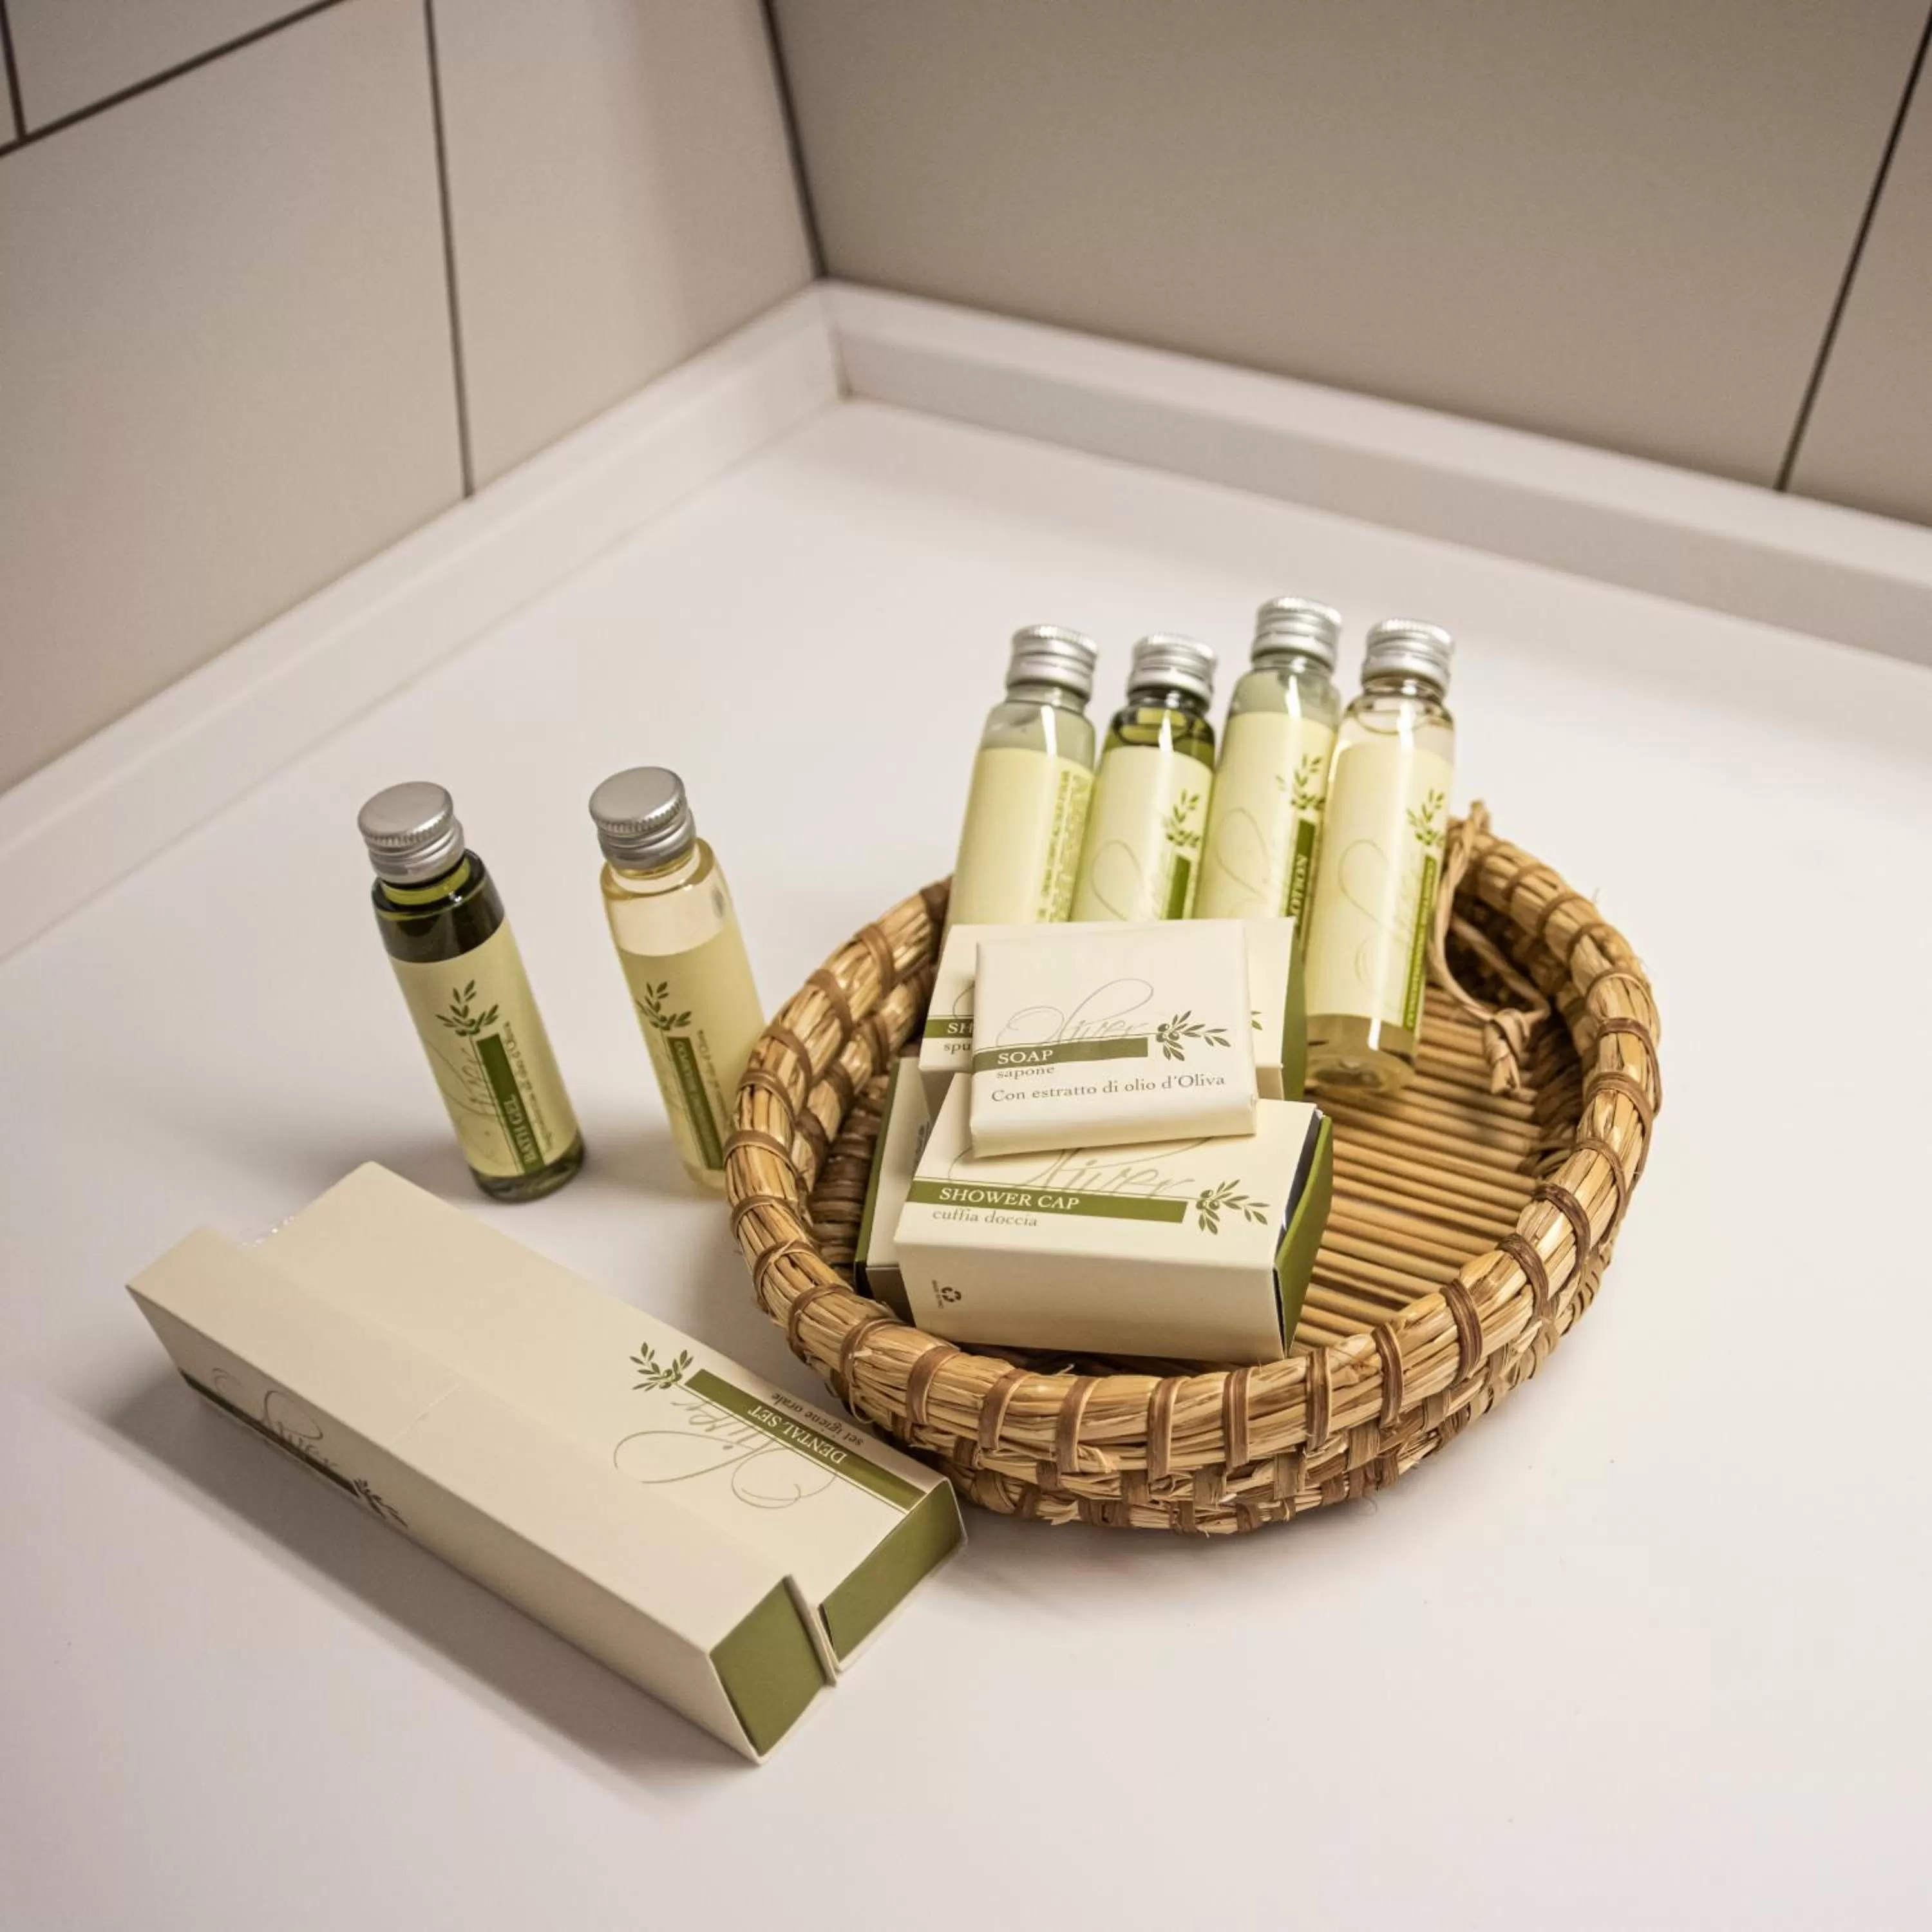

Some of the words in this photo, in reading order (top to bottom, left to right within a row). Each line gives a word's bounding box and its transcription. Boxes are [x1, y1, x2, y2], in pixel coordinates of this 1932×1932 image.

[996, 1049, 1054, 1065] SOAP
[996, 1065, 1055, 1080] sapone
[991, 1089, 1025, 1102] Con
[1032, 1084, 1097, 1099] estratto
[1103, 1079, 1119, 1094] di
[1124, 1077, 1156, 1092] olio
[1161, 1073, 1225, 1089] d'Oliva
[939, 1187, 1032, 1207] SHOWER
[1037, 1195, 1080, 1209] CAP
[933, 1207, 980, 1222] cuffia
[984, 1212, 1038, 1227] doccia
[770, 1392, 807, 1416] orale
[746, 1404, 785, 1428] SET
[800, 1408, 843, 1439] igiene
[781, 1419, 848, 1464] DENTAL
[842, 1431, 864, 1448] set
